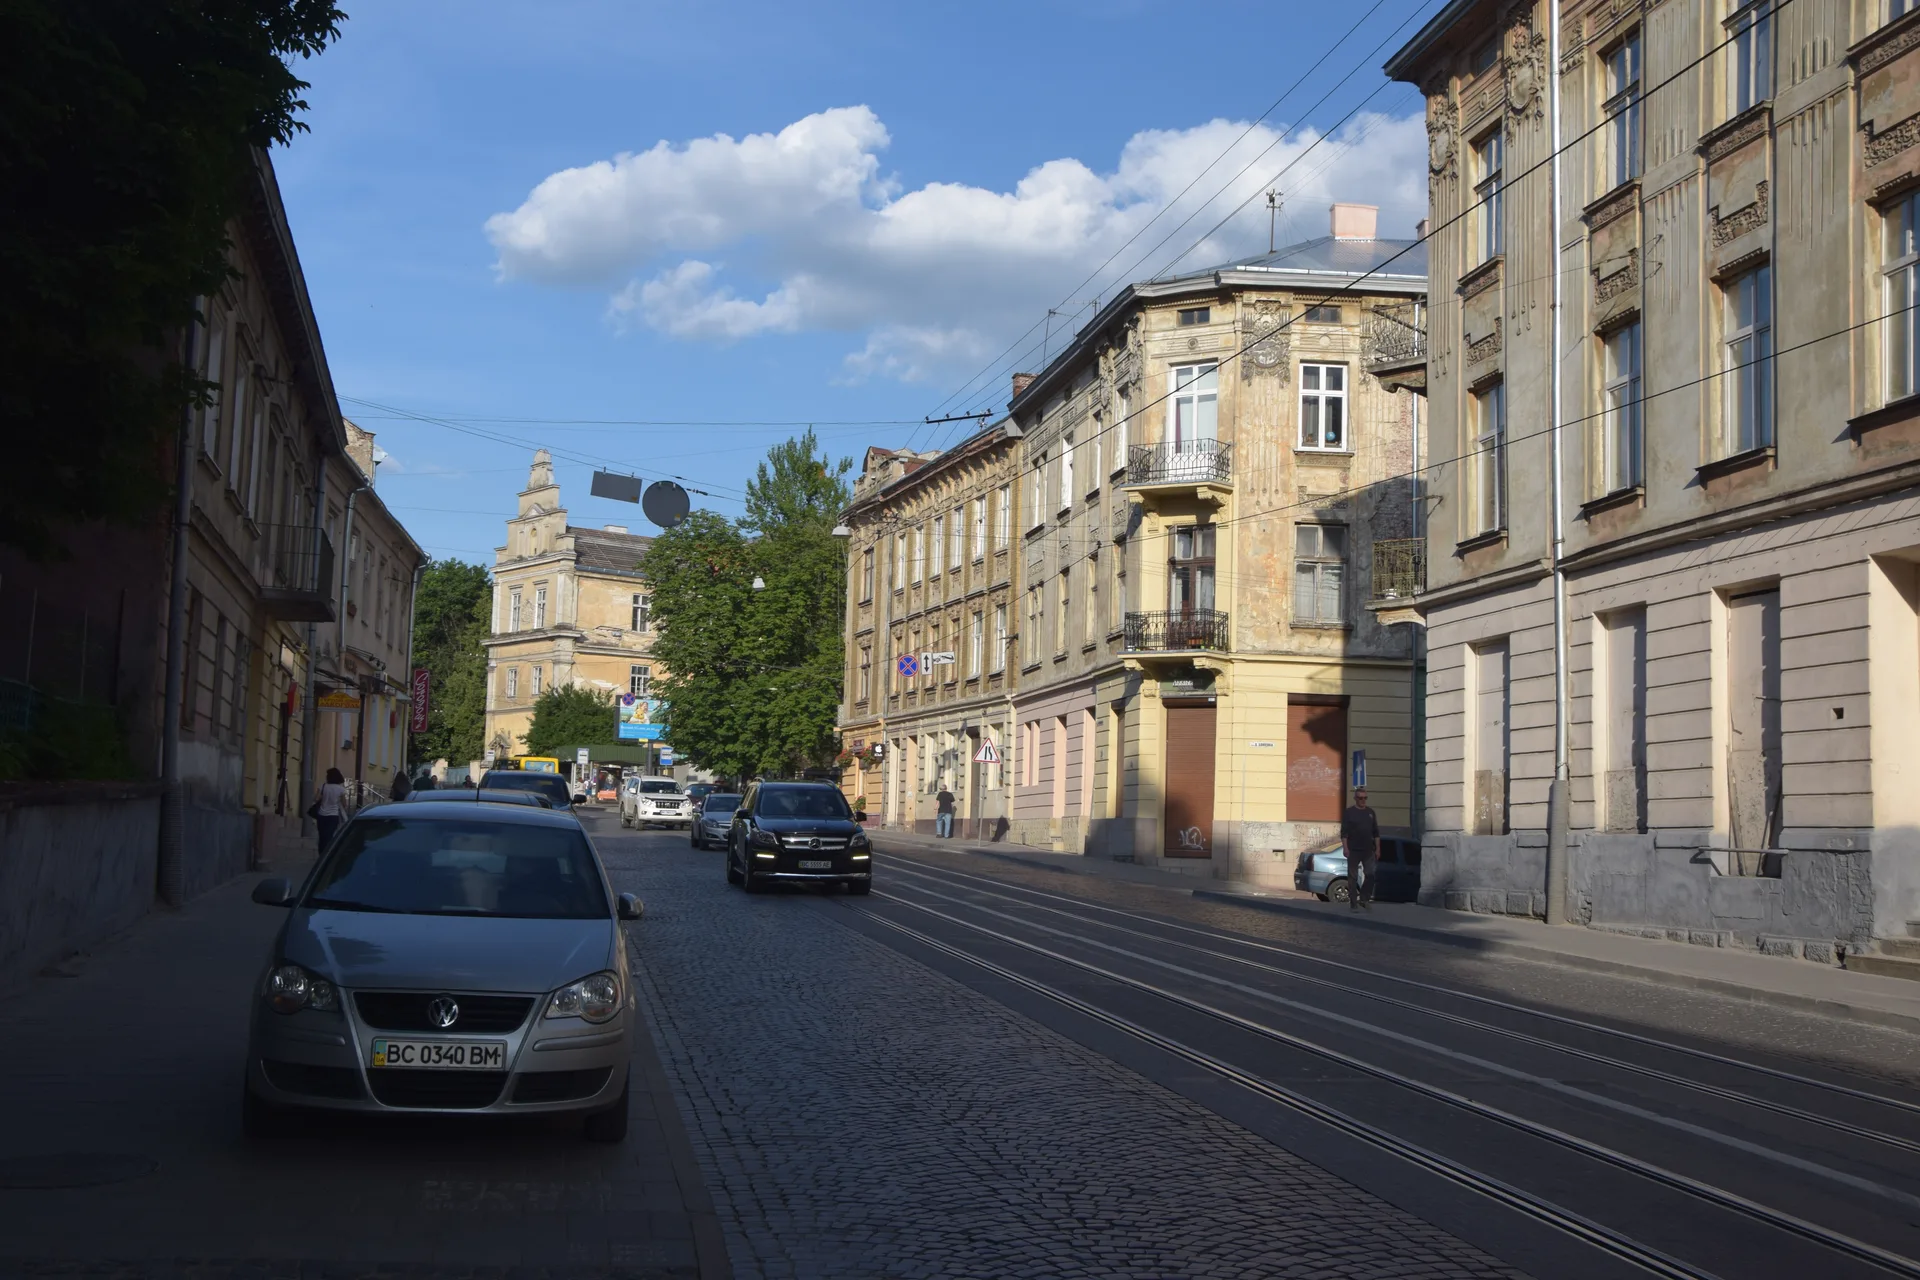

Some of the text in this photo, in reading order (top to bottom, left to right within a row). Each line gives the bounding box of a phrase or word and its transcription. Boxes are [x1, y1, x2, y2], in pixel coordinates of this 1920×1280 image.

[387, 1044, 498, 1065] BC 0340 BM
